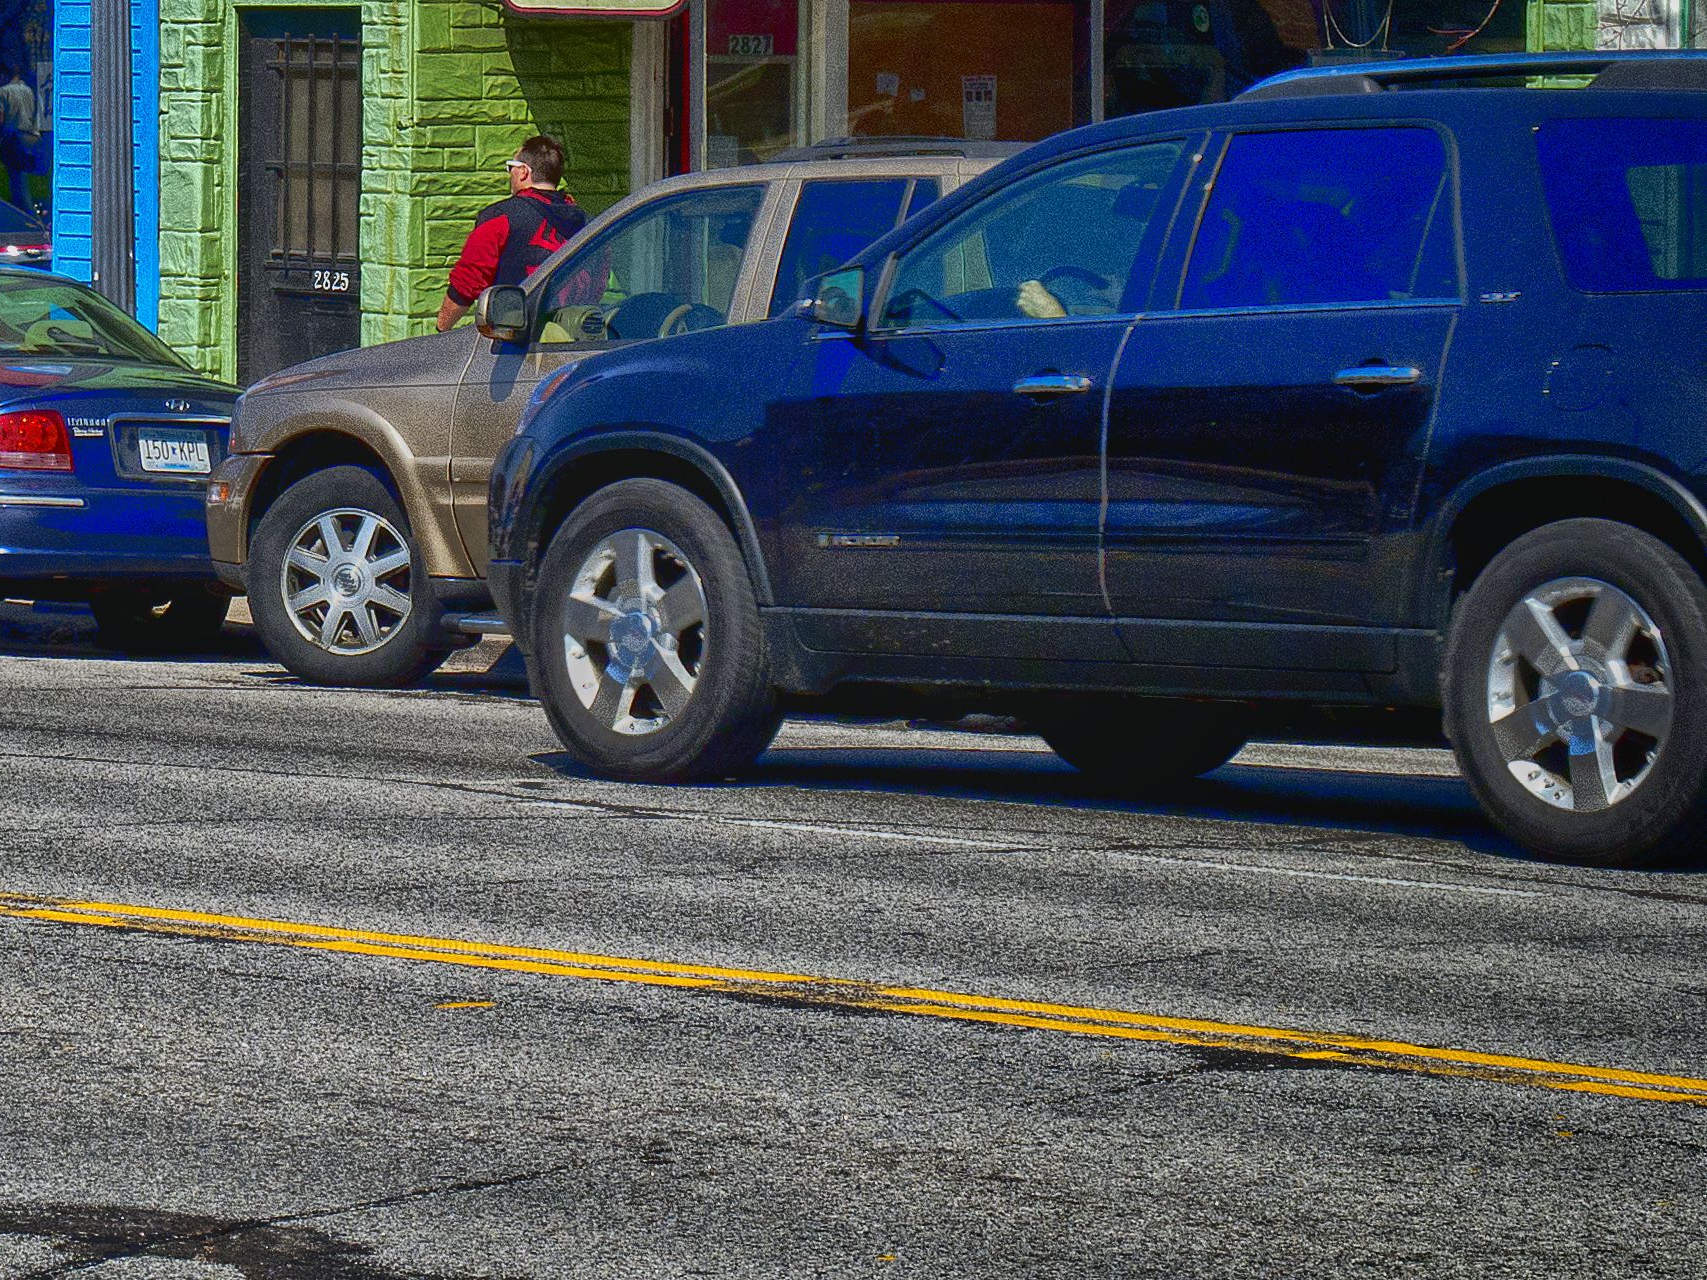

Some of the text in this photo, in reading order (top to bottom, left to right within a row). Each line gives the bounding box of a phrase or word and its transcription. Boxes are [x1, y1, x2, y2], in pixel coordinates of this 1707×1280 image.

[729, 35, 773, 56] 2827
[314, 270, 350, 291] 2825
[145, 439, 205, 463] 150 KPL
